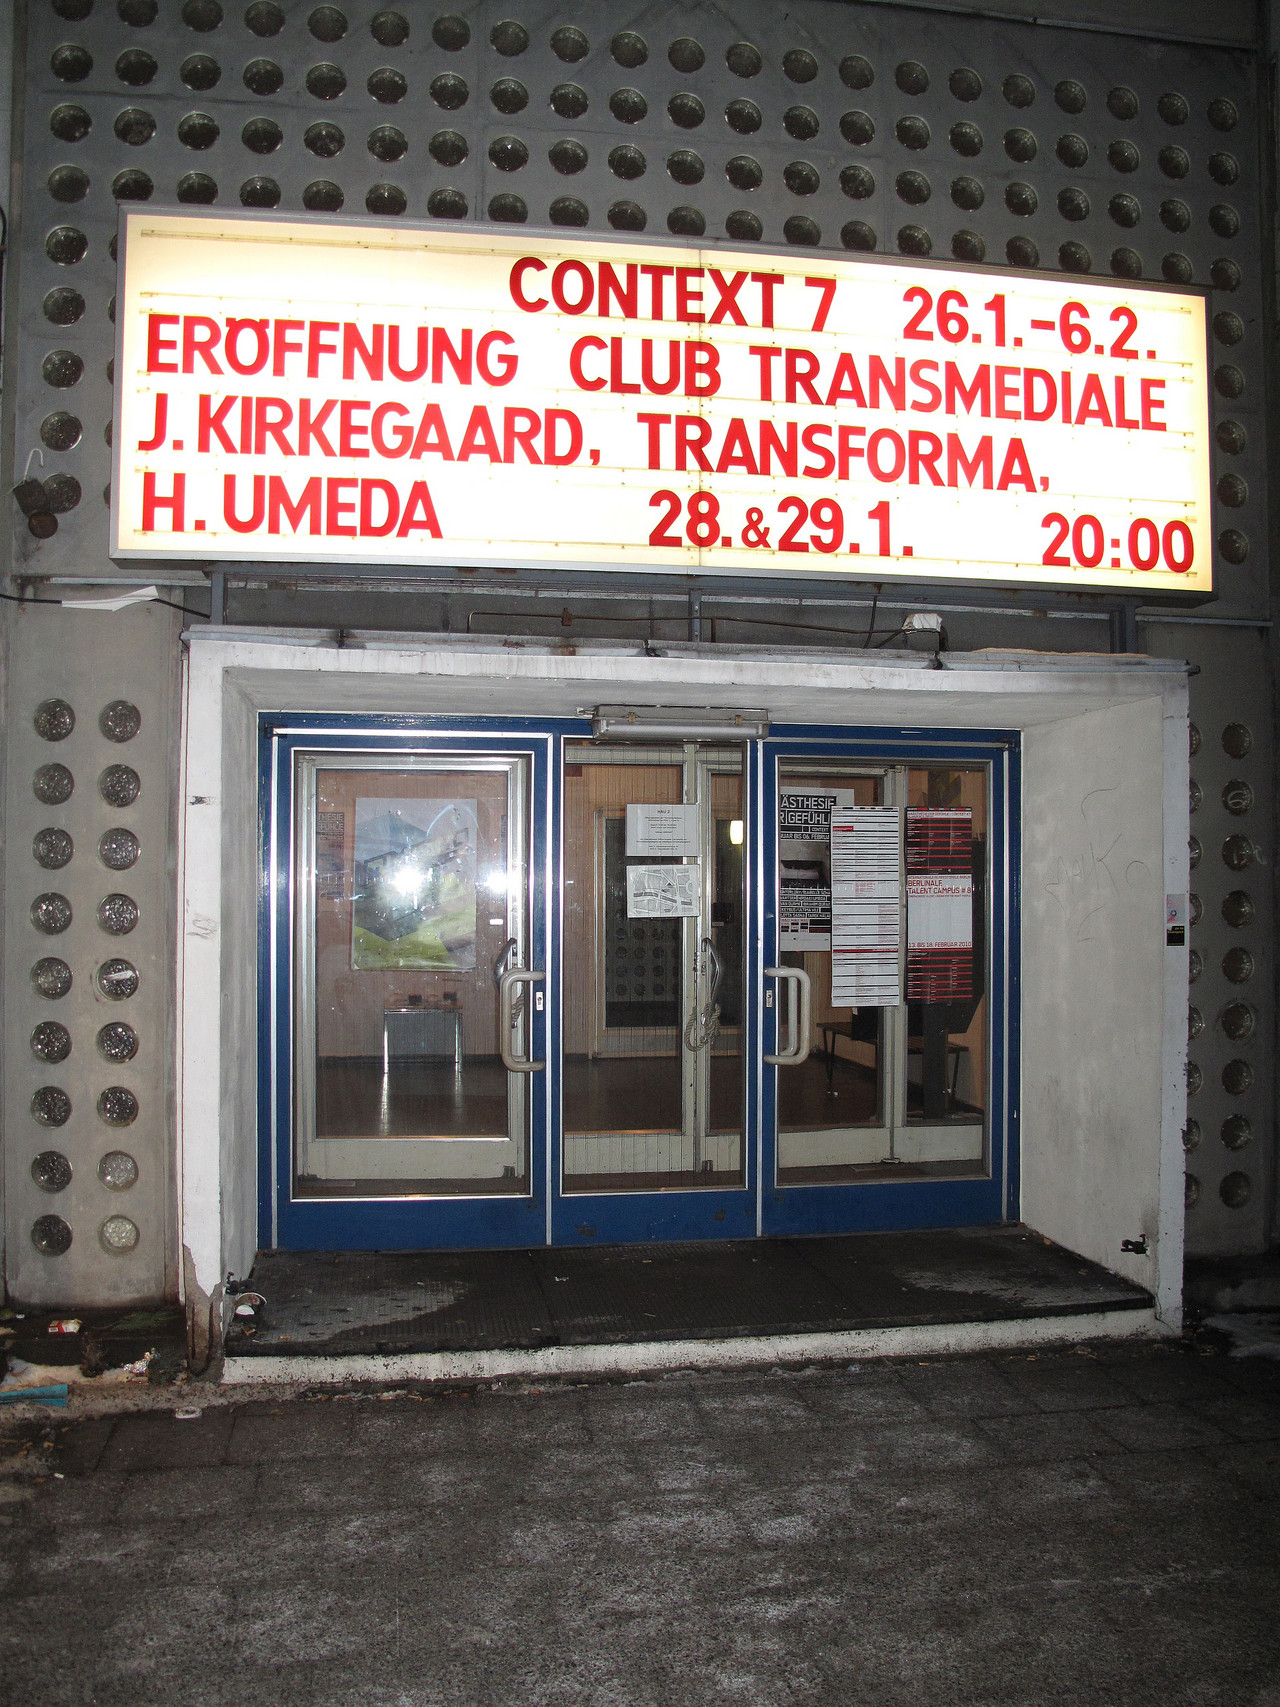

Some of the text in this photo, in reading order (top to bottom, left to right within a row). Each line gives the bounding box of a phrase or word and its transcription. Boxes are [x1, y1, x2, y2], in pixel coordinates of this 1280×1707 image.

[510, 257, 785, 328] CONTEXT
[804, 276, 837, 332] 7
[146, 313, 1167, 432] ERÖFFNUNG CLUB TRANSMEDIALE
[636, 412, 1050, 493] TRANSFORMA,
[1040, 512, 1195, 574] 20:00
[788, 811, 830, 824] GEFÜHL
